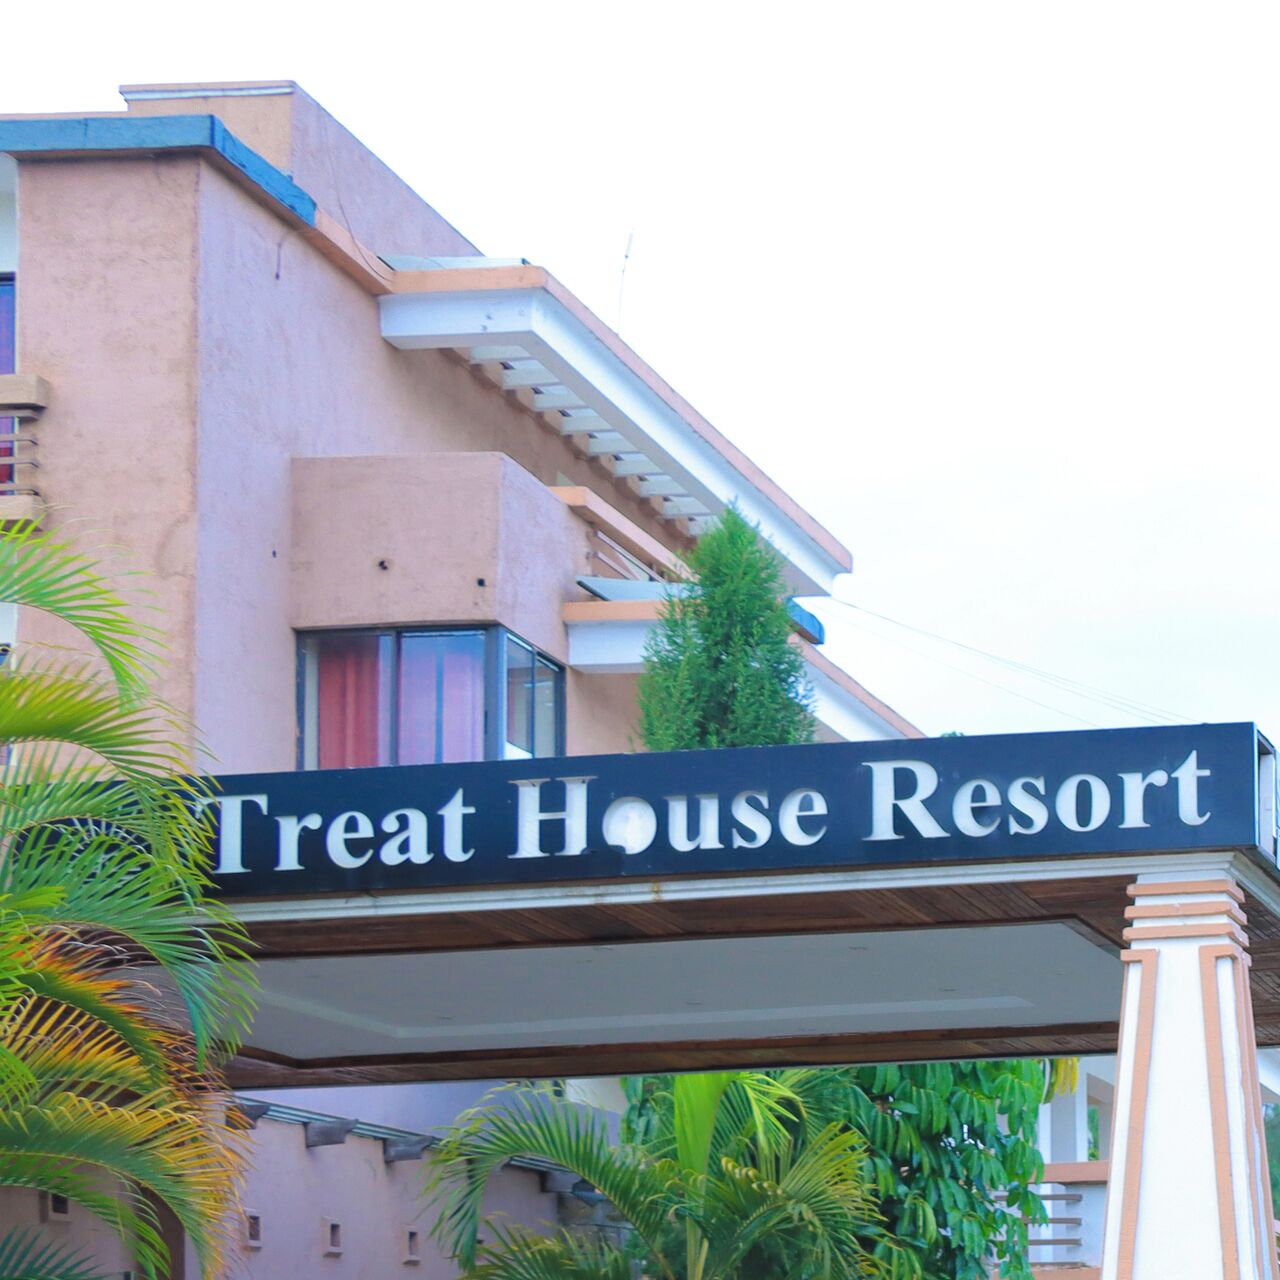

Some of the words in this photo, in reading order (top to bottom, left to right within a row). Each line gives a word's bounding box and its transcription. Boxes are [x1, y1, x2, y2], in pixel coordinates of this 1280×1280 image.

[195, 788, 475, 873] Treat
[508, 776, 827, 858] House
[862, 749, 1211, 841] Resort
